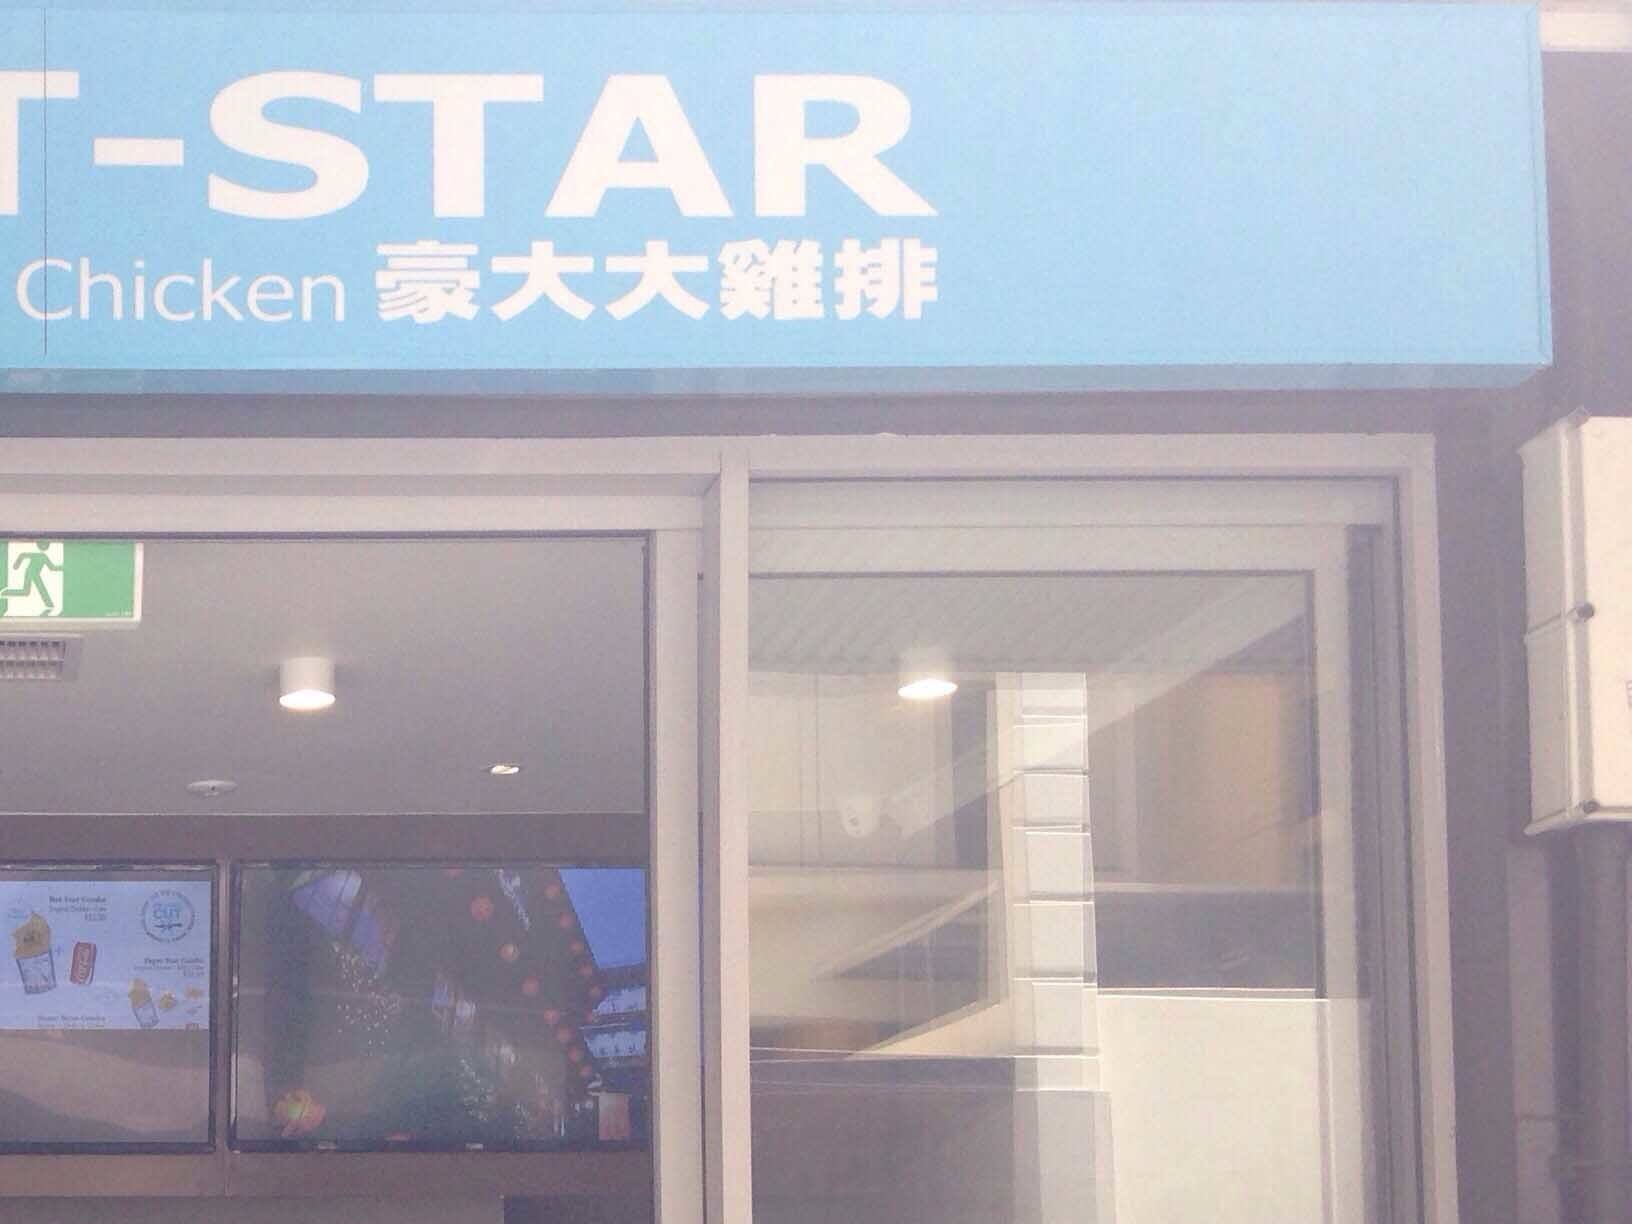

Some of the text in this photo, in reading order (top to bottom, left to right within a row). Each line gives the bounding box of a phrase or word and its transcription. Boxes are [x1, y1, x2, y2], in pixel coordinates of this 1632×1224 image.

[16, 257, 346, 323] Chicken
[374, 238, 939, 323] 豪大大雞排
